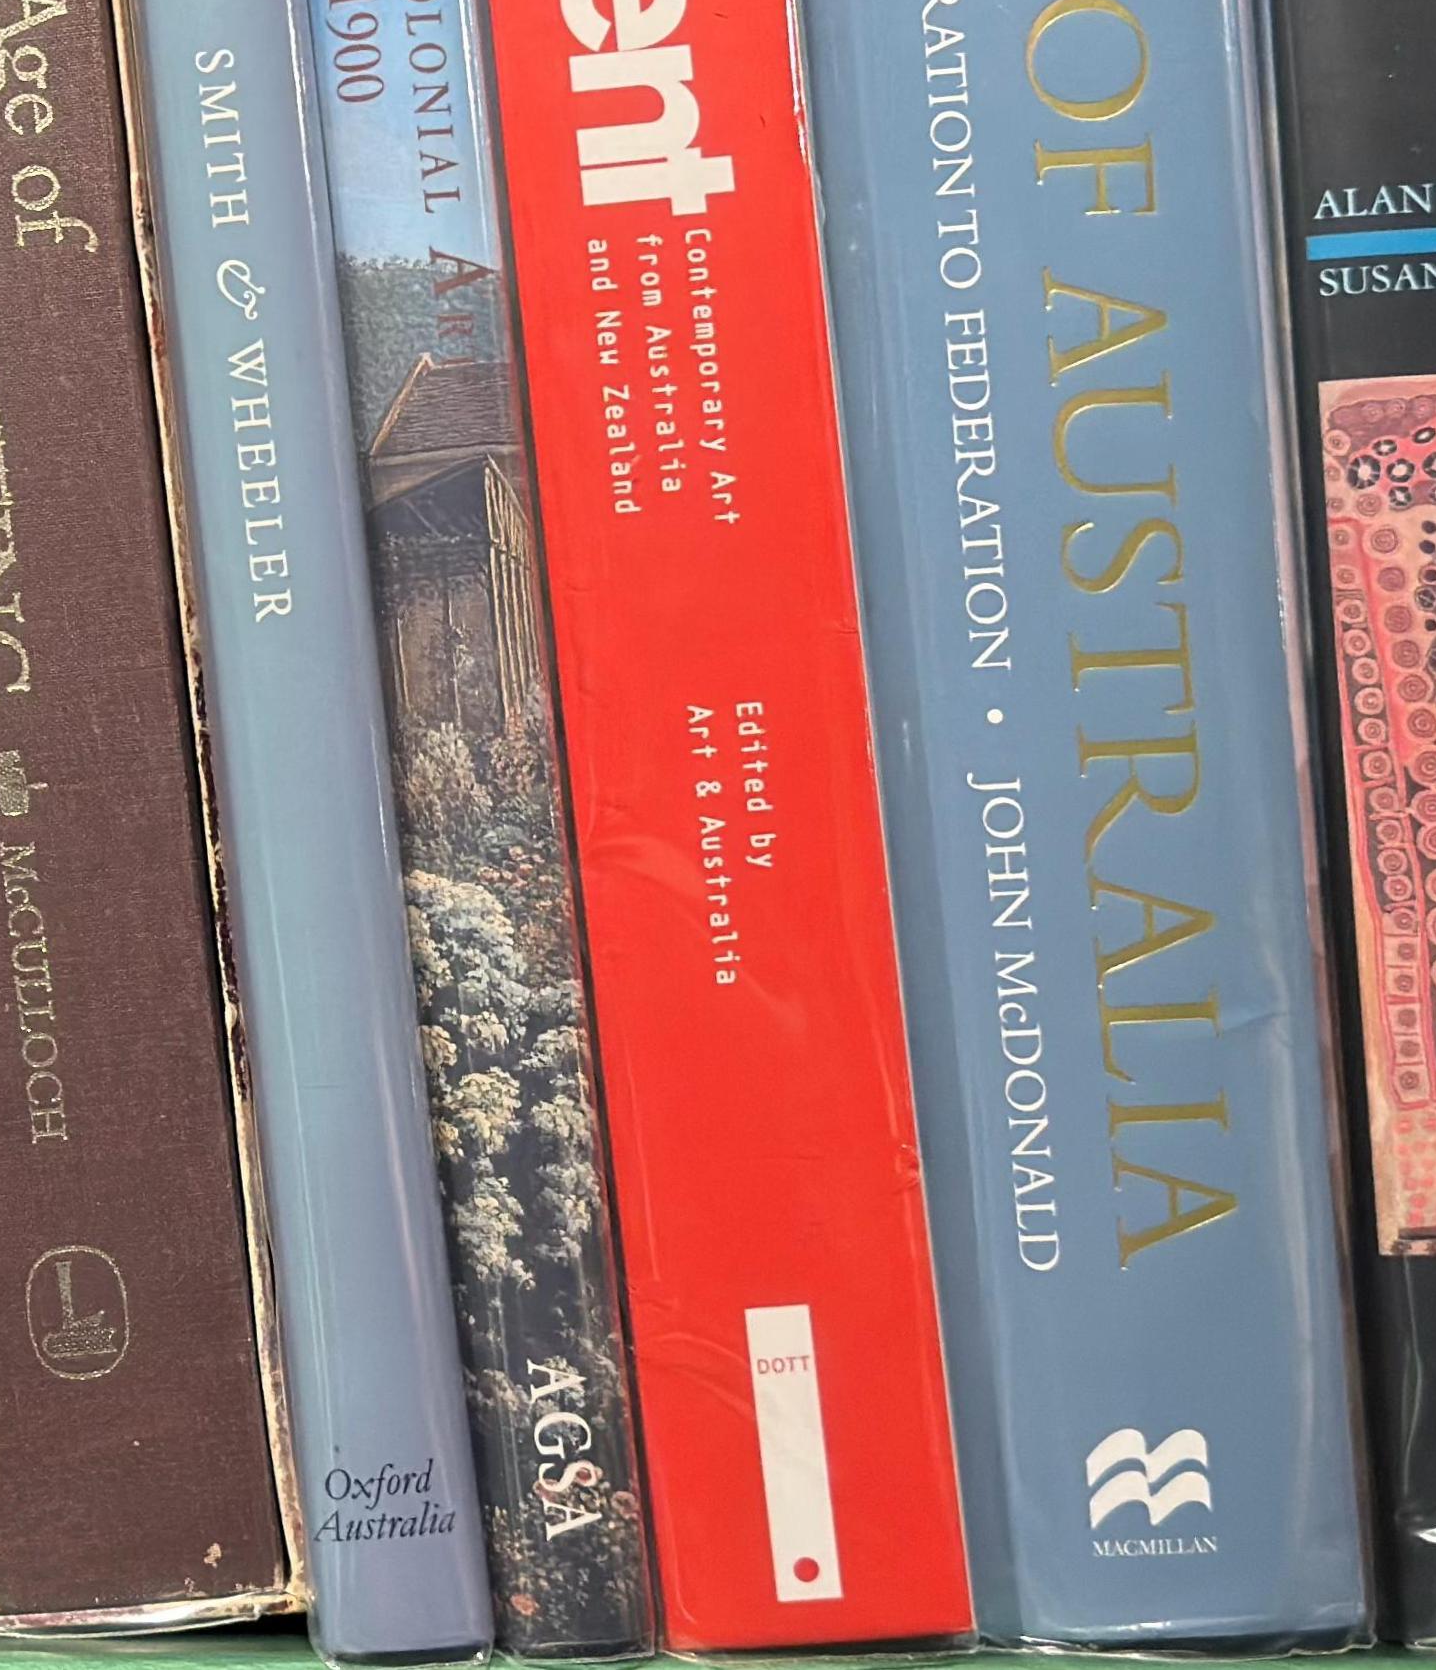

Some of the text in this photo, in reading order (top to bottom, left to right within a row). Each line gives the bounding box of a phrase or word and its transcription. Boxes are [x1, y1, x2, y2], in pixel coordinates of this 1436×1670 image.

[11, 167, 98, 252] of
[1313, 183, 1433, 220] ALAN
[194, 49, 291, 623] SMITH & WHEELER
[587, 239, 642, 514] and New Zealand
[636, 233, 686, 493] from Australia
[685, 229, 740, 524] Contemporary Art
[686, 705, 741, 985] Art & Australia
[736, 702, 777, 868] Edited by
[1043, 266, 1240, 1271] AUSTRALIA
[0, 842, 68, 1144] McCULLOCH
[966, 771, 1061, 1273] JOHN McDONALD
[527, 1358, 603, 1543] AGSA
[756, 1354, 811, 1376] DOTT
[315, 1501, 455, 1542] Australia
[325, 1459, 433, 1509] Oxford
[1092, 1536, 1218, 1558] MACMILLAN
